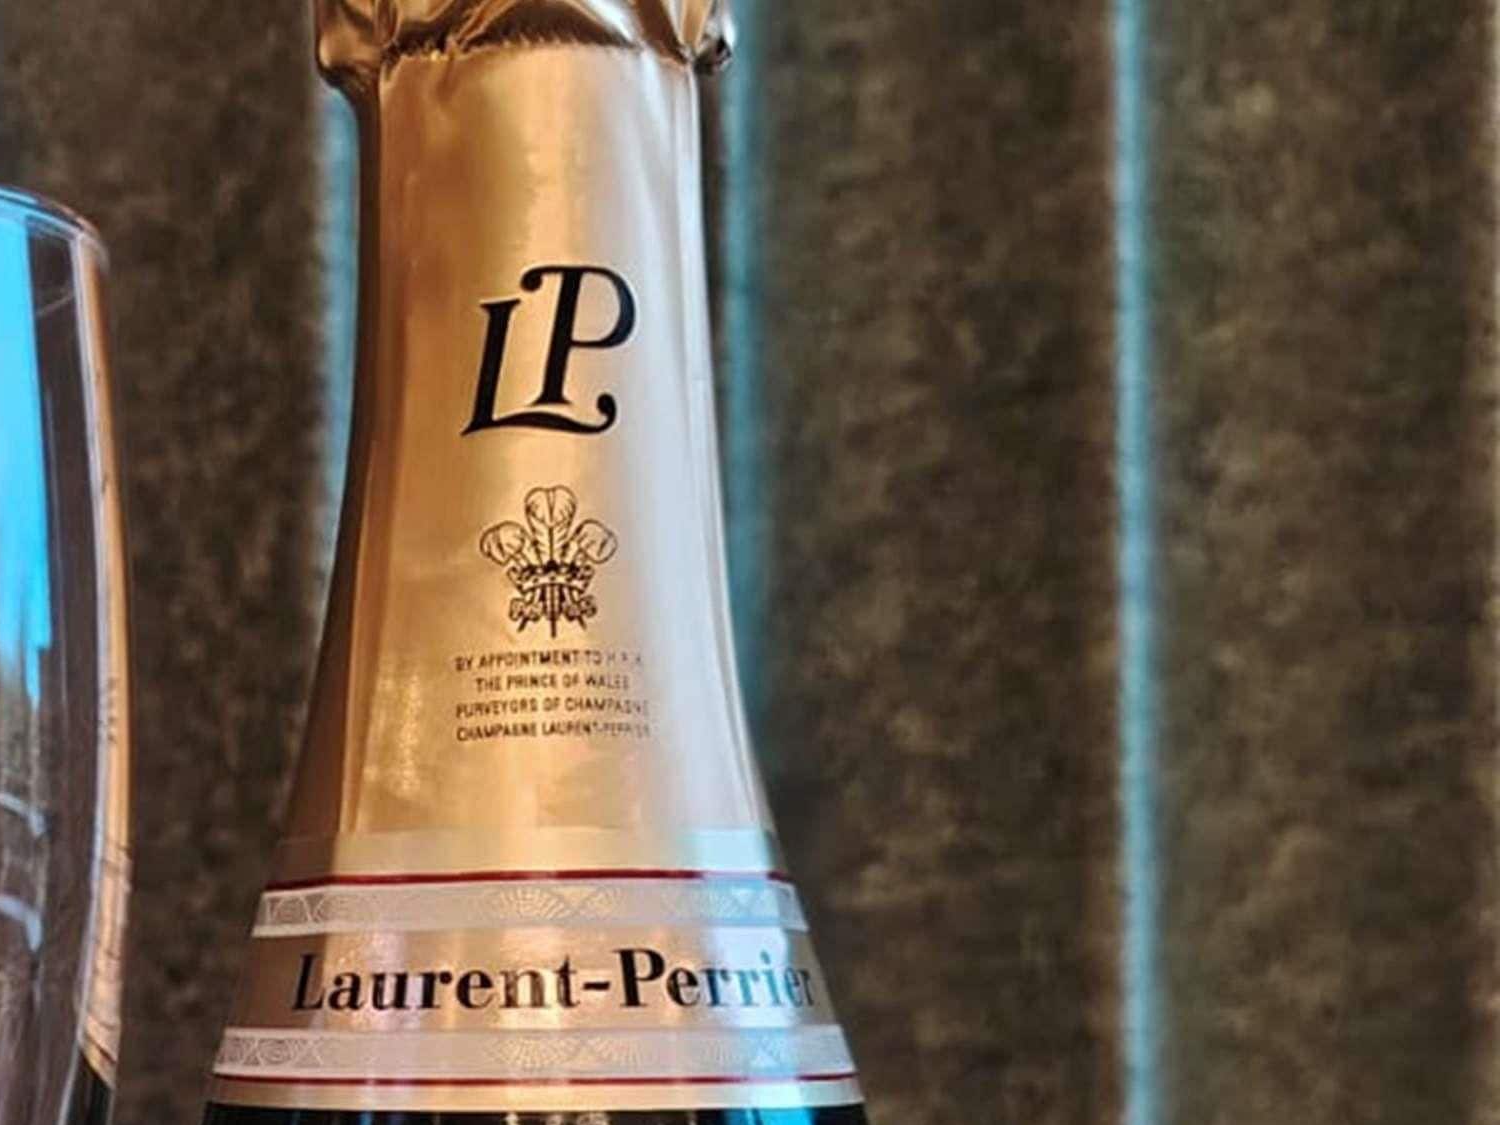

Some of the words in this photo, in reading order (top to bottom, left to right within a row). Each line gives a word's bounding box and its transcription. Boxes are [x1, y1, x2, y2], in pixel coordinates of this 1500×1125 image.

[461, 265, 637, 437] LP
[456, 655, 473, 672] BY
[478, 650, 578, 669] APPOINTMENT
[476, 675, 501, 693] THE
[506, 673, 556, 690] PRINCE
[561, 672, 580, 689] OF
[542, 697, 560, 712] OF
[292, 948, 814, 1011] Laurent-Perrier
